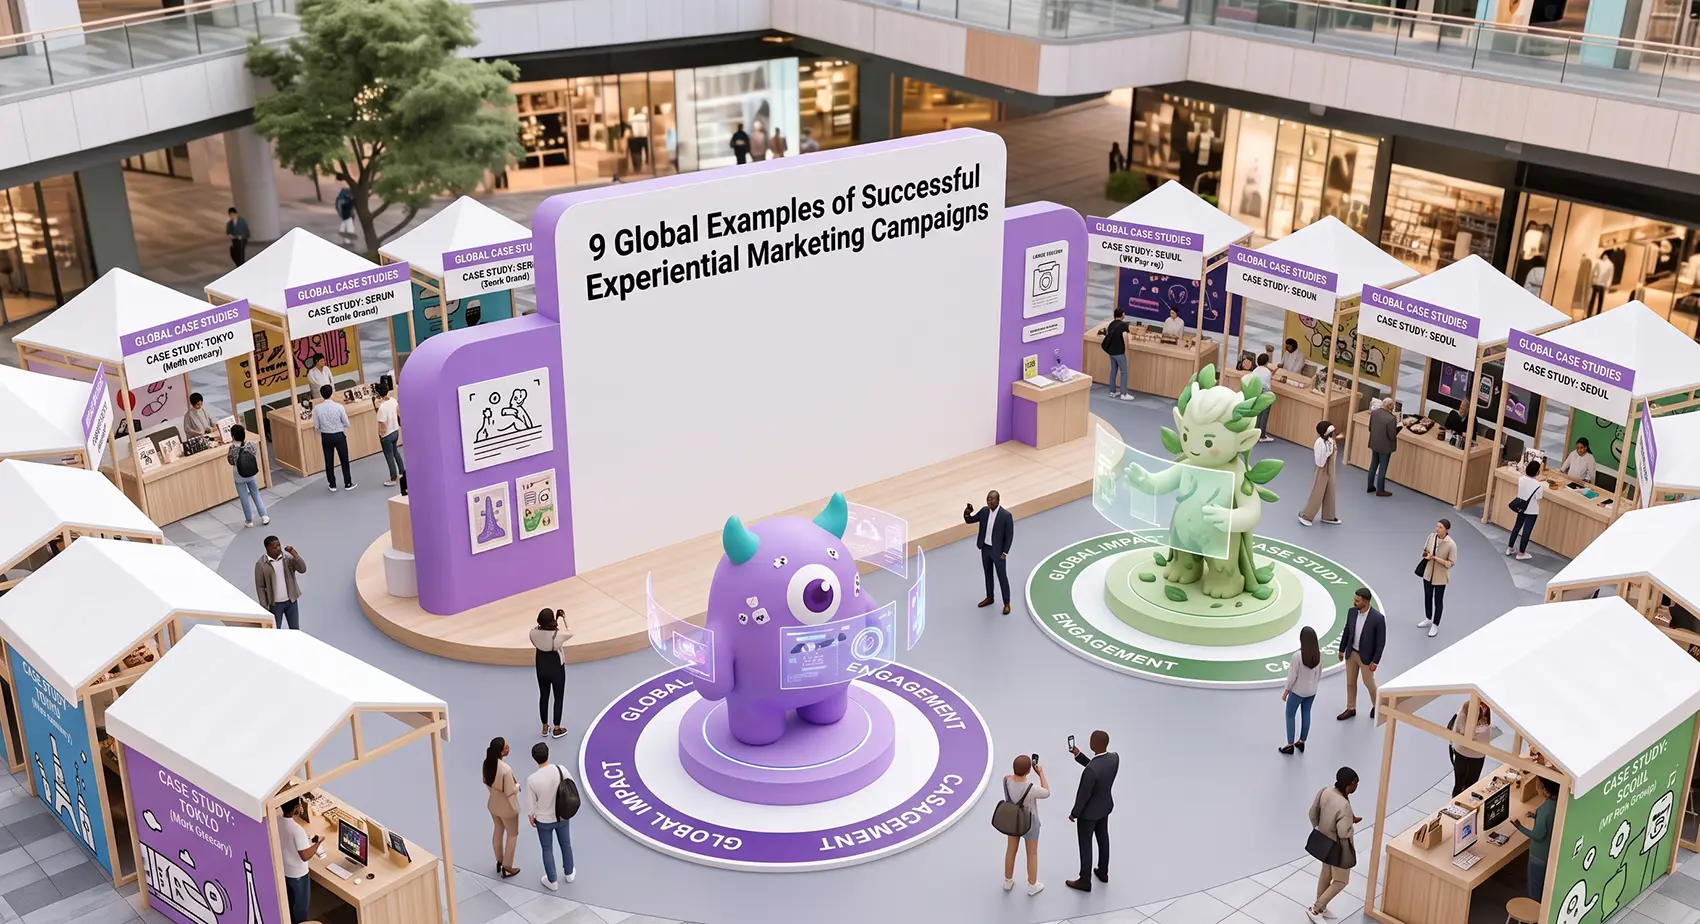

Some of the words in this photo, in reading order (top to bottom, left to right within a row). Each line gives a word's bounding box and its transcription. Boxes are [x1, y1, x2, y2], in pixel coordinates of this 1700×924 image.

[588, 233, 606, 261] 9
[614, 214, 699, 256] Global
[707, 196, 825, 240] Examples
[832, 185, 856, 215] of
[862, 163, 980, 209] Successful
[454, 251, 489, 264] GLOBAL
[491, 246, 514, 258] CASE
[516, 242, 532, 253] STU
[586, 245, 740, 301] Experiential
[748, 226, 865, 268] Marketing
[871, 201, 990, 243] Campaigns
[1096, 222, 1128, 236] GLOBAL
[1130, 228, 1153, 240] CASE
[1154, 231, 1192, 246] STUDIES
[1102, 241, 1122, 252] CASE
[1124, 245, 1154, 257] STUDY:
[298, 285, 334, 301] GLOBAL
[336, 280, 360, 292] CASE
[362, 269, 399, 286] STUDIES
[462, 270, 484, 282] CASE
[486, 264, 516, 277] STUDY:
[1236, 252, 1268, 269] GLOBAL
[1269, 261, 1290, 275] CASE
[1292, 267, 1327, 284] STUDIES
[1242, 272, 1262, 286] CASE
[1262, 278, 1290, 294] STUDY:
[1291, 286, 1318, 301] SEOUN
[308, 306, 332, 318] CASE
[333, 298, 364, 313] STUDY:
[366, 290, 394, 305] SERUN
[1372, 292, 1405, 311] GLOBAL
[1406, 303, 1430, 318] CASE
[1430, 310, 1468, 330] STUDIES
[135, 328, 172, 347] GLOBAL
[174, 320, 200, 336] CASE
[200, 308, 239, 328] STUDIES
[1376, 314, 1398, 329] CASE
[1398, 320, 1428, 338] STUDY:
[1429, 331, 1457, 348] SEOUL
[146, 350, 170, 365] CASE
[172, 340, 204, 358] STUDY:
[204, 331, 234, 347] TOKYO
[1519, 338, 1554, 359] GLOBAL
[1556, 351, 1580, 368] CASE
[1582, 360, 1622, 382] STUDIES
[1523, 361, 1546, 378] CASE
[1547, 370, 1578, 389] STUDY:
[1048, 548, 1102, 581] GLOBAL
[1252, 542, 1294, 558] ASE
[1292, 556, 1348, 586] STUDY
[1052, 612, 1178, 670] ENGAGEMENT
[620, 678, 694, 721] GLOBAL
[846, 662, 967, 731] ENGAGEMENT
[1604, 766, 1630, 796] CASE
[1632, 738, 1668, 775] STUDY:
[158, 770, 190, 798] CASE
[192, 789, 235, 826] STUDY:
[601, 761, 652, 816] IMPACT
[650, 812, 742, 850] GLOBAL
[820, 774, 964, 852] CASAGEMENT
